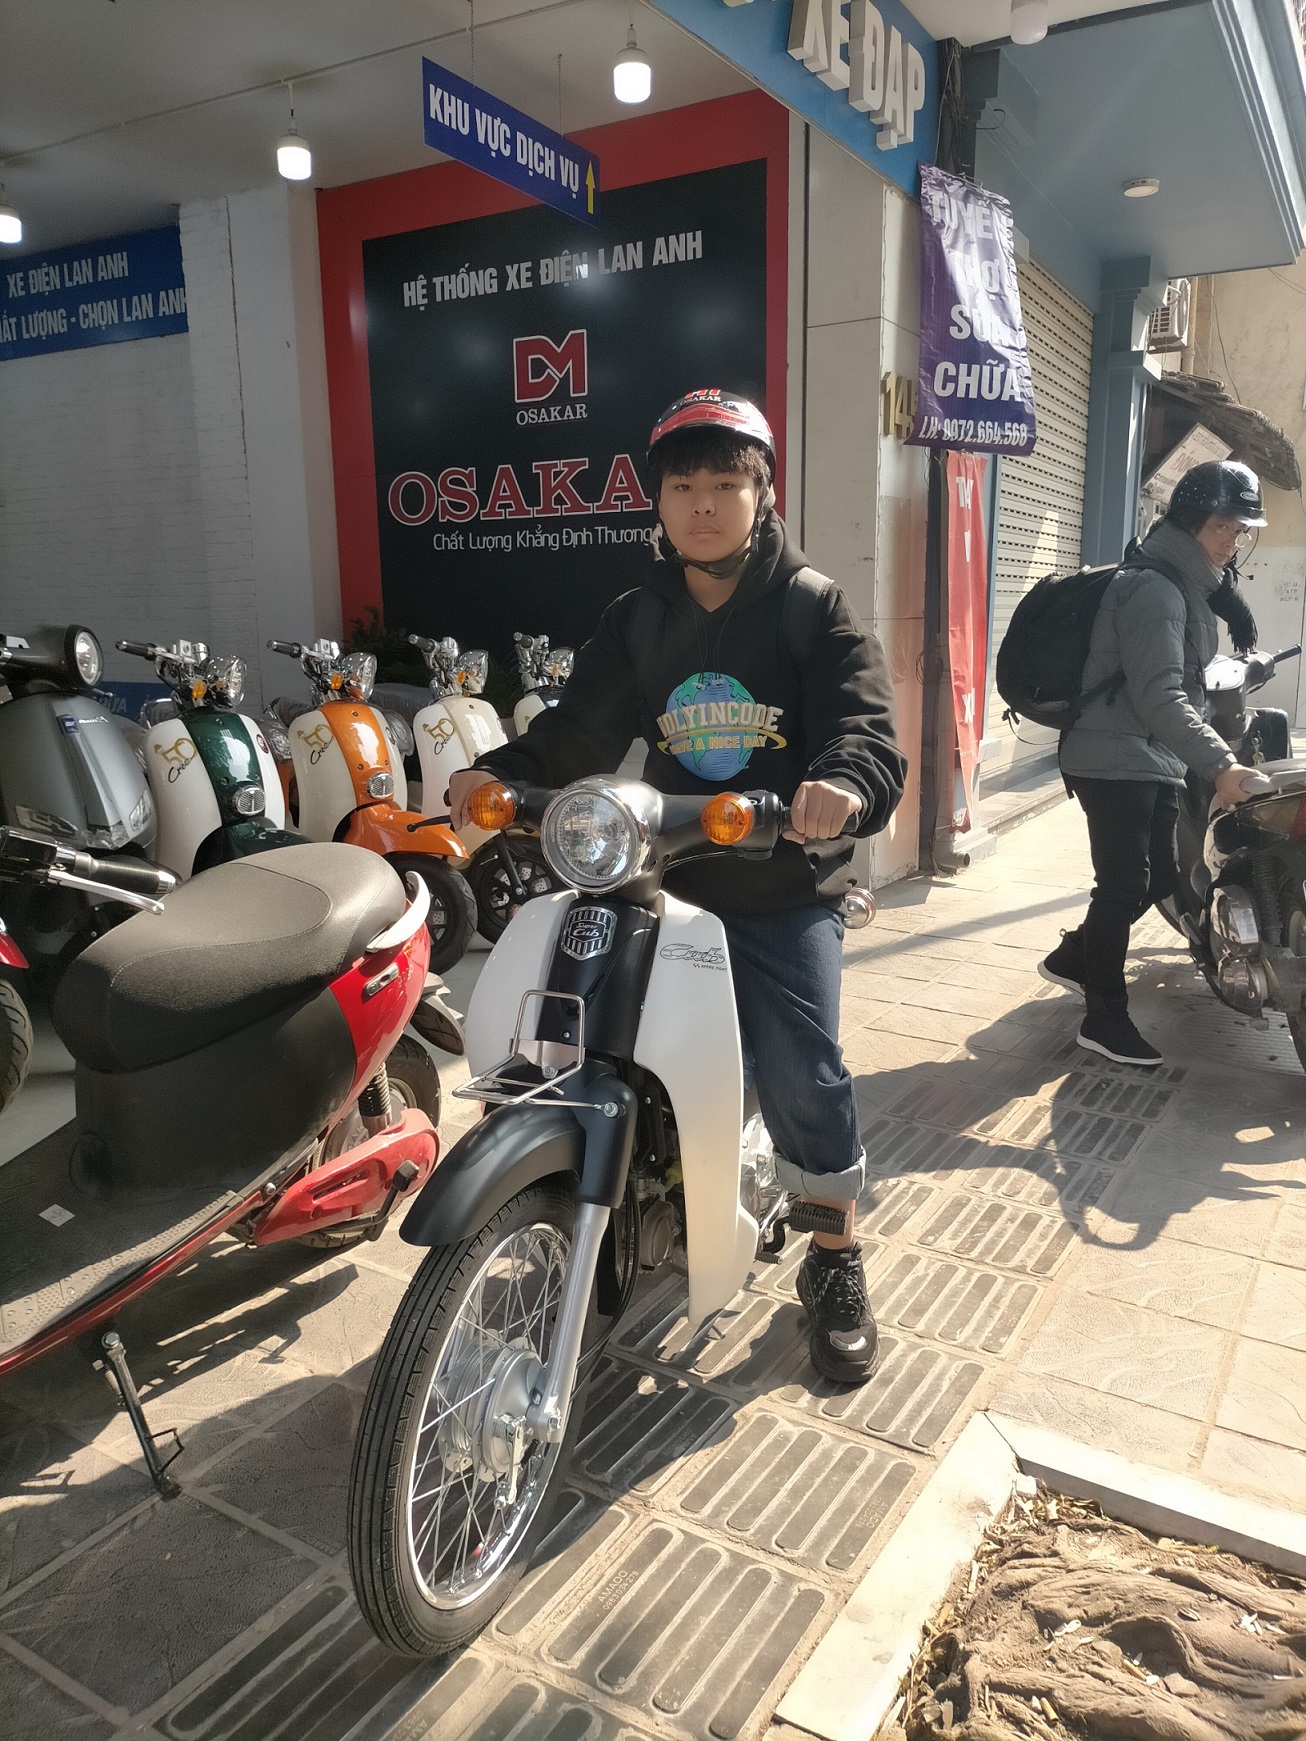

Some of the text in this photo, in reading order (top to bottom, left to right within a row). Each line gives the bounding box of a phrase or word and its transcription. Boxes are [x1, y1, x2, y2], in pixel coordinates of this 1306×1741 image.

[849, 0, 925, 151] ĐẠP
[429, 83, 580, 199] KHU VỰC DỊCH VỤ
[6, 251, 129, 298] XE ĐIỆN LAN ANH
[403, 230, 703, 311] HỆ THỐNG XE ĐIỆN LAN ANH
[21, 307, 68, 340] LƯỢNG
[78, 298, 119, 331] CHỌN
[122, 292, 154, 323] LAN
[158, 287, 188, 317] ANH
[933, 358, 1025, 403] CHỮA
[516, 403, 588, 426] OSAKAR
[388, 453, 653, 526] OSAKA
[433, 524, 653, 552] Chất Lượng Khẳng Định Thương
[695, 738, 706, 750] A
[708, 736, 741, 749] NICE
[743, 735, 768, 748] DAY
[598, 1570, 628, 1603] AMADO
